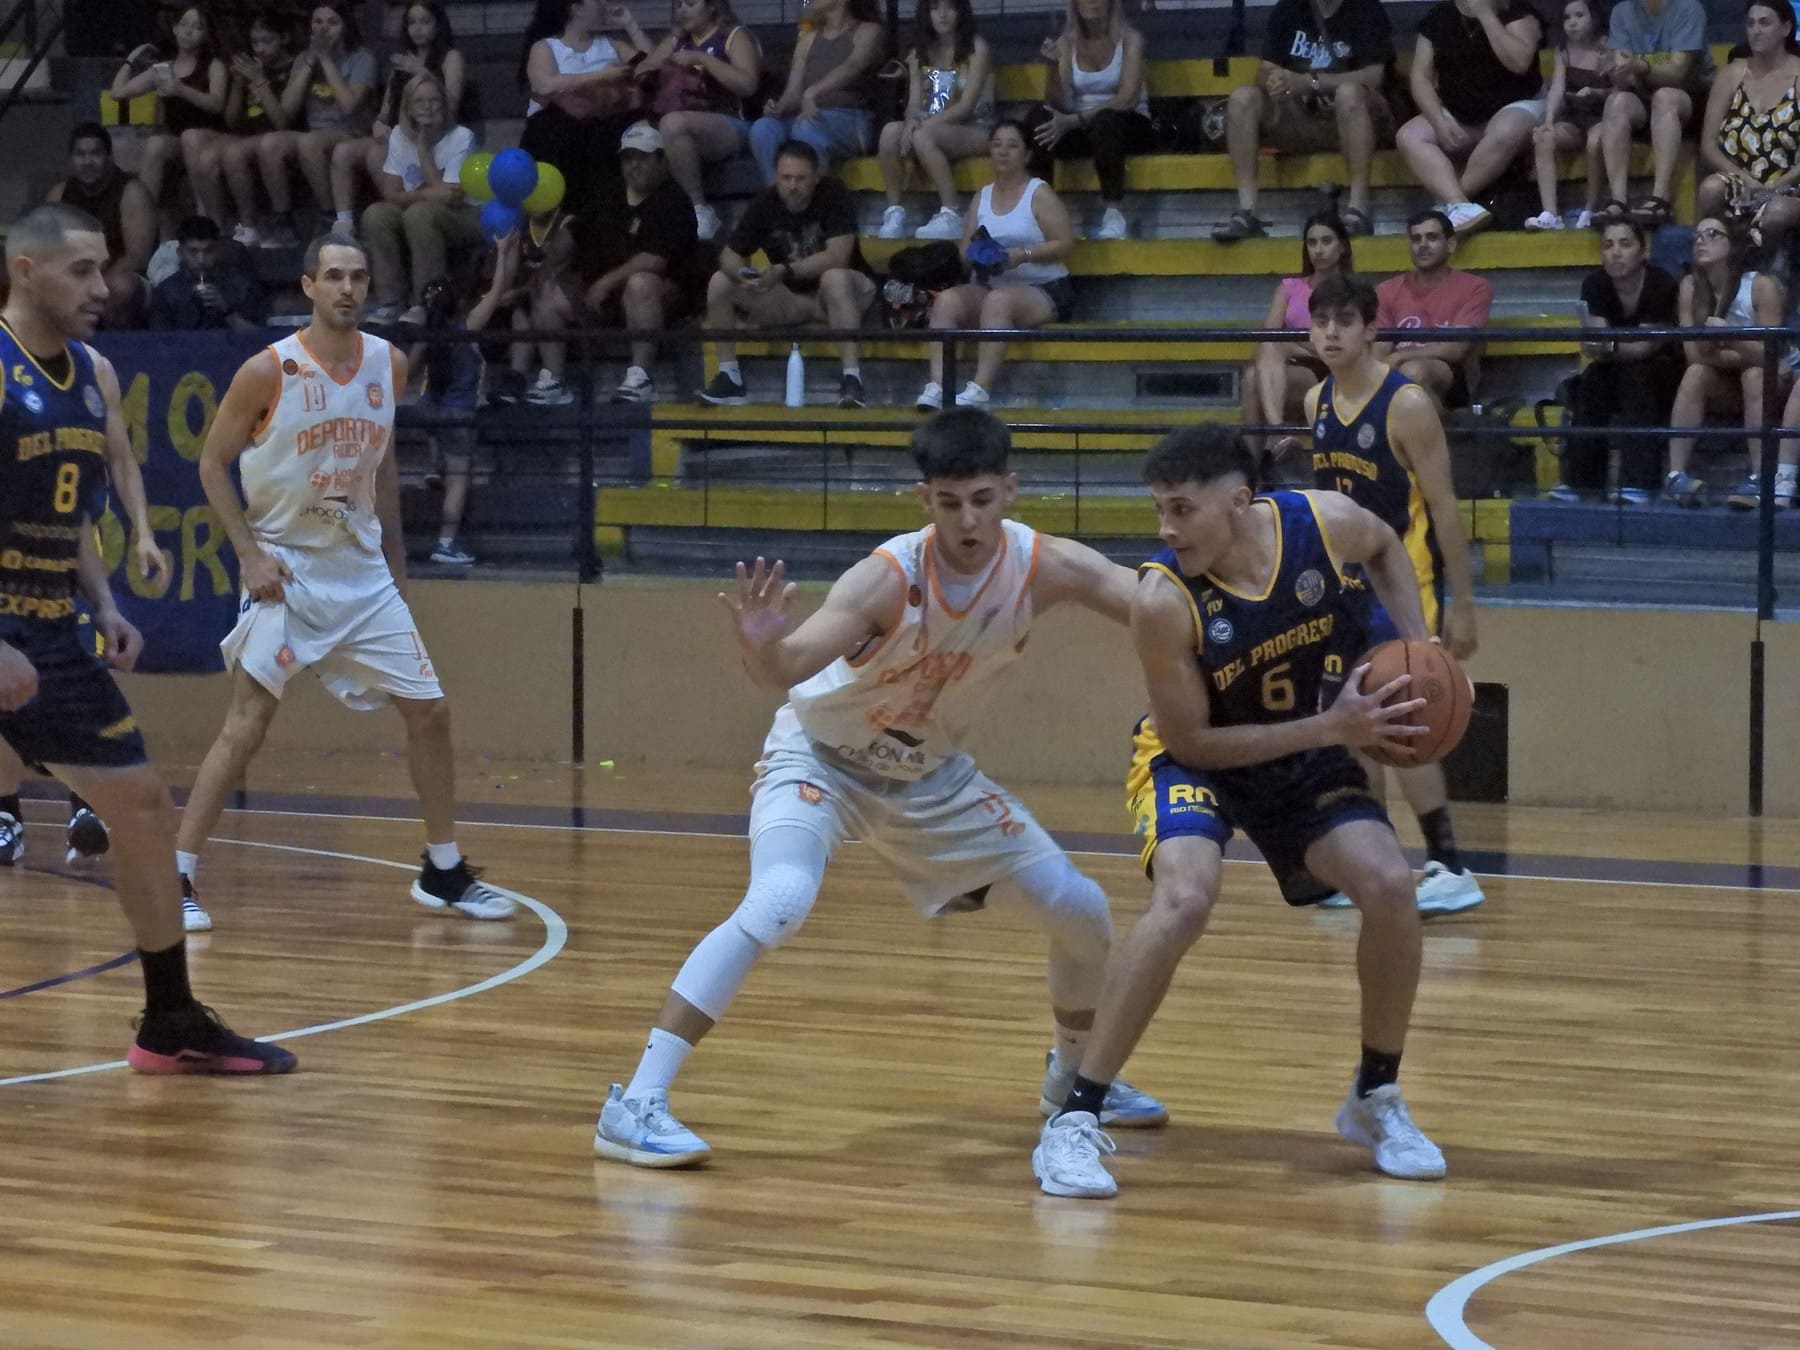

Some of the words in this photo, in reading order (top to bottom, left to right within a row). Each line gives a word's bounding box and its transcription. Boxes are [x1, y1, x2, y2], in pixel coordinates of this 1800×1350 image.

[54, 462, 79, 513] 8
[1213, 659, 1246, 691] DEL
[1262, 662, 1296, 711] 6
